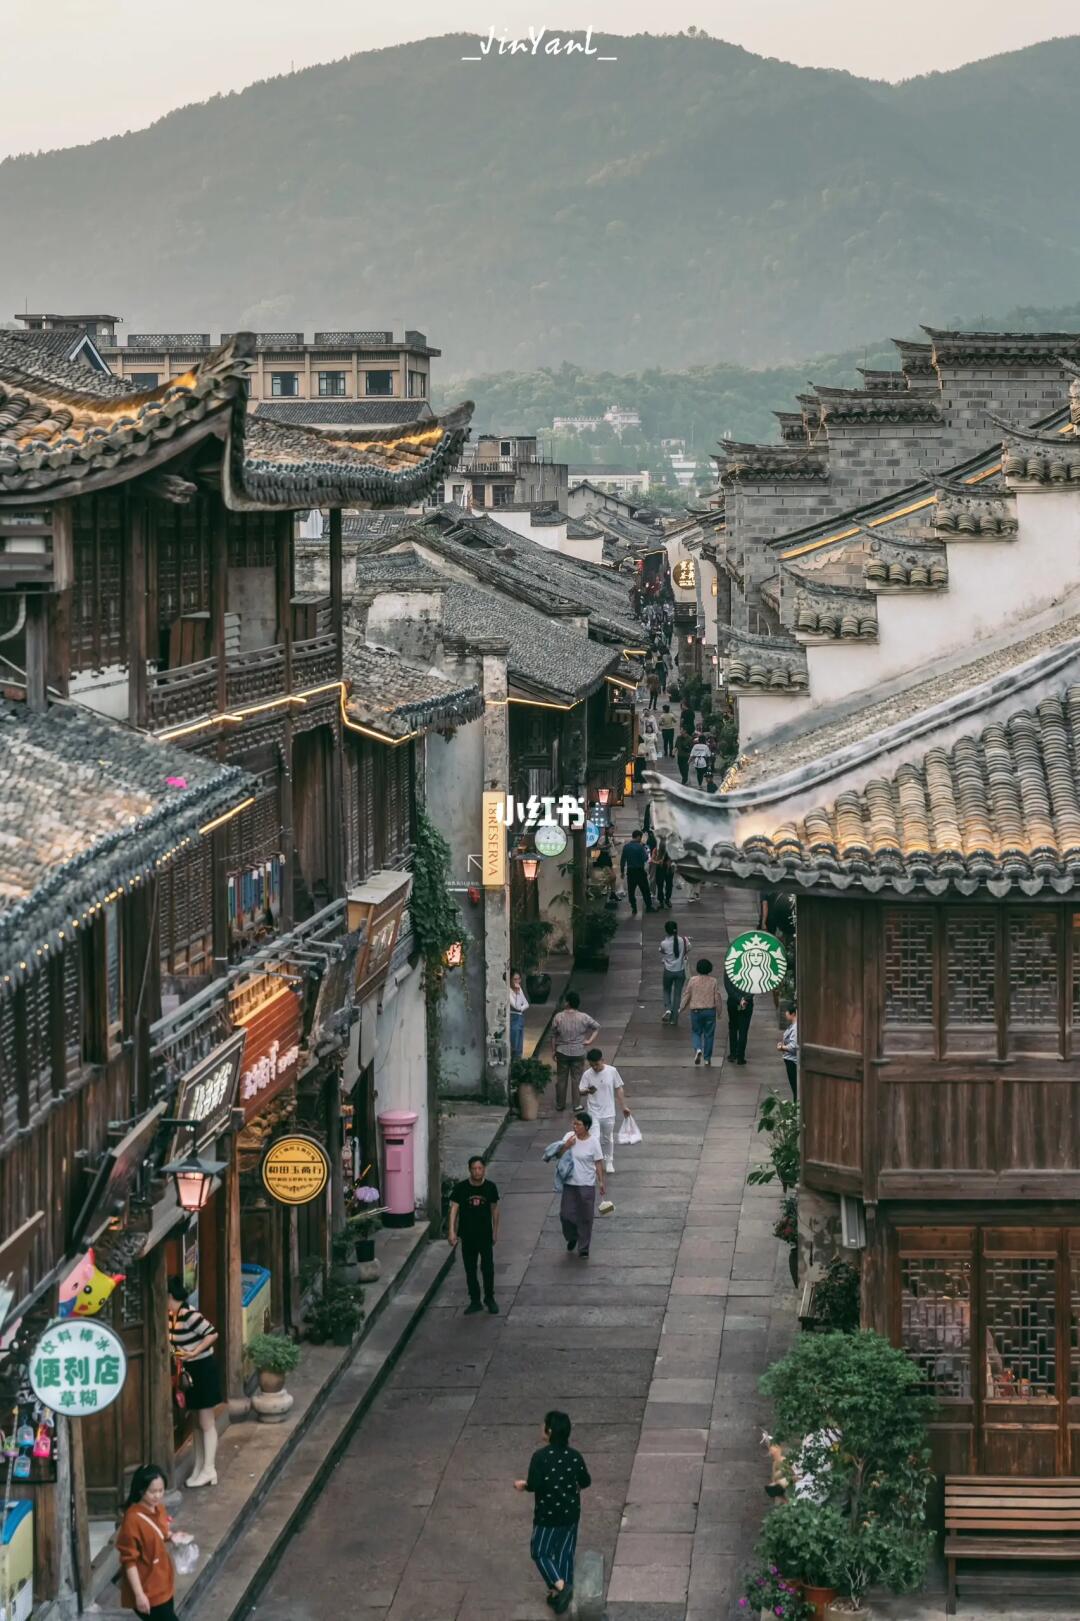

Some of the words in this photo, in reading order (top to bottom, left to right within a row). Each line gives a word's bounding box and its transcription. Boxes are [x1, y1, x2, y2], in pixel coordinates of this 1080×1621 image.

[34, 1354, 120, 1388] 便利店
[59, 1389, 98, 1407] 草糊
